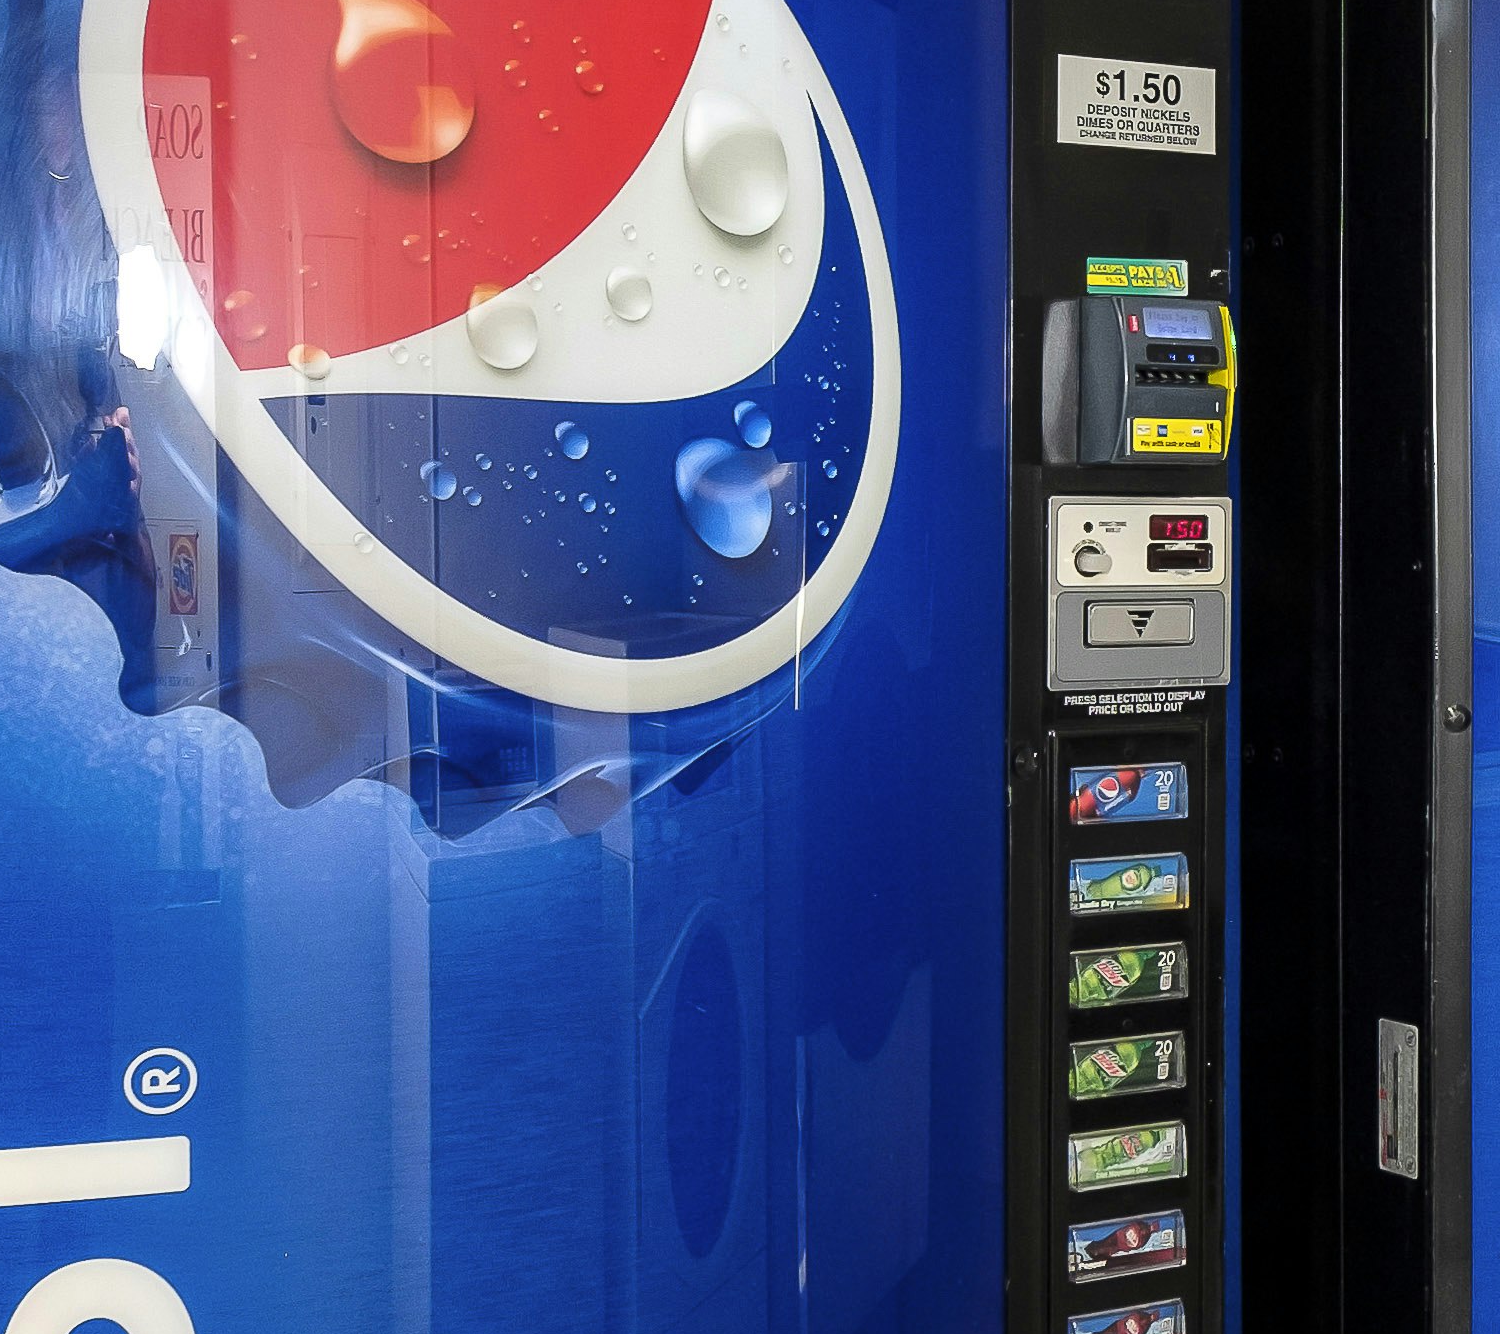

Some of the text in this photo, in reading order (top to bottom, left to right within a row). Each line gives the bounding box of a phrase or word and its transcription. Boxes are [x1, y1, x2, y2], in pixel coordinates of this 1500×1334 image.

[1096, 70, 1182, 106] $1.50
[1087, 104, 1191, 123] DEPOSIT NICKELS
[1076, 116, 1200, 137] DIMES OR QUARTERS
[1079, 130, 1198, 146] CHANGE RETURNED BELOW
[1064, 690, 1206, 706] PRESS SELECTION TO DISPLAY
[1088, 702, 1183, 716] PRICE OR SOLD OUT
[1154, 770, 1174, 787] 20
[1157, 950, 1176, 967] 20
[1154, 1039, 1173, 1057] 20
